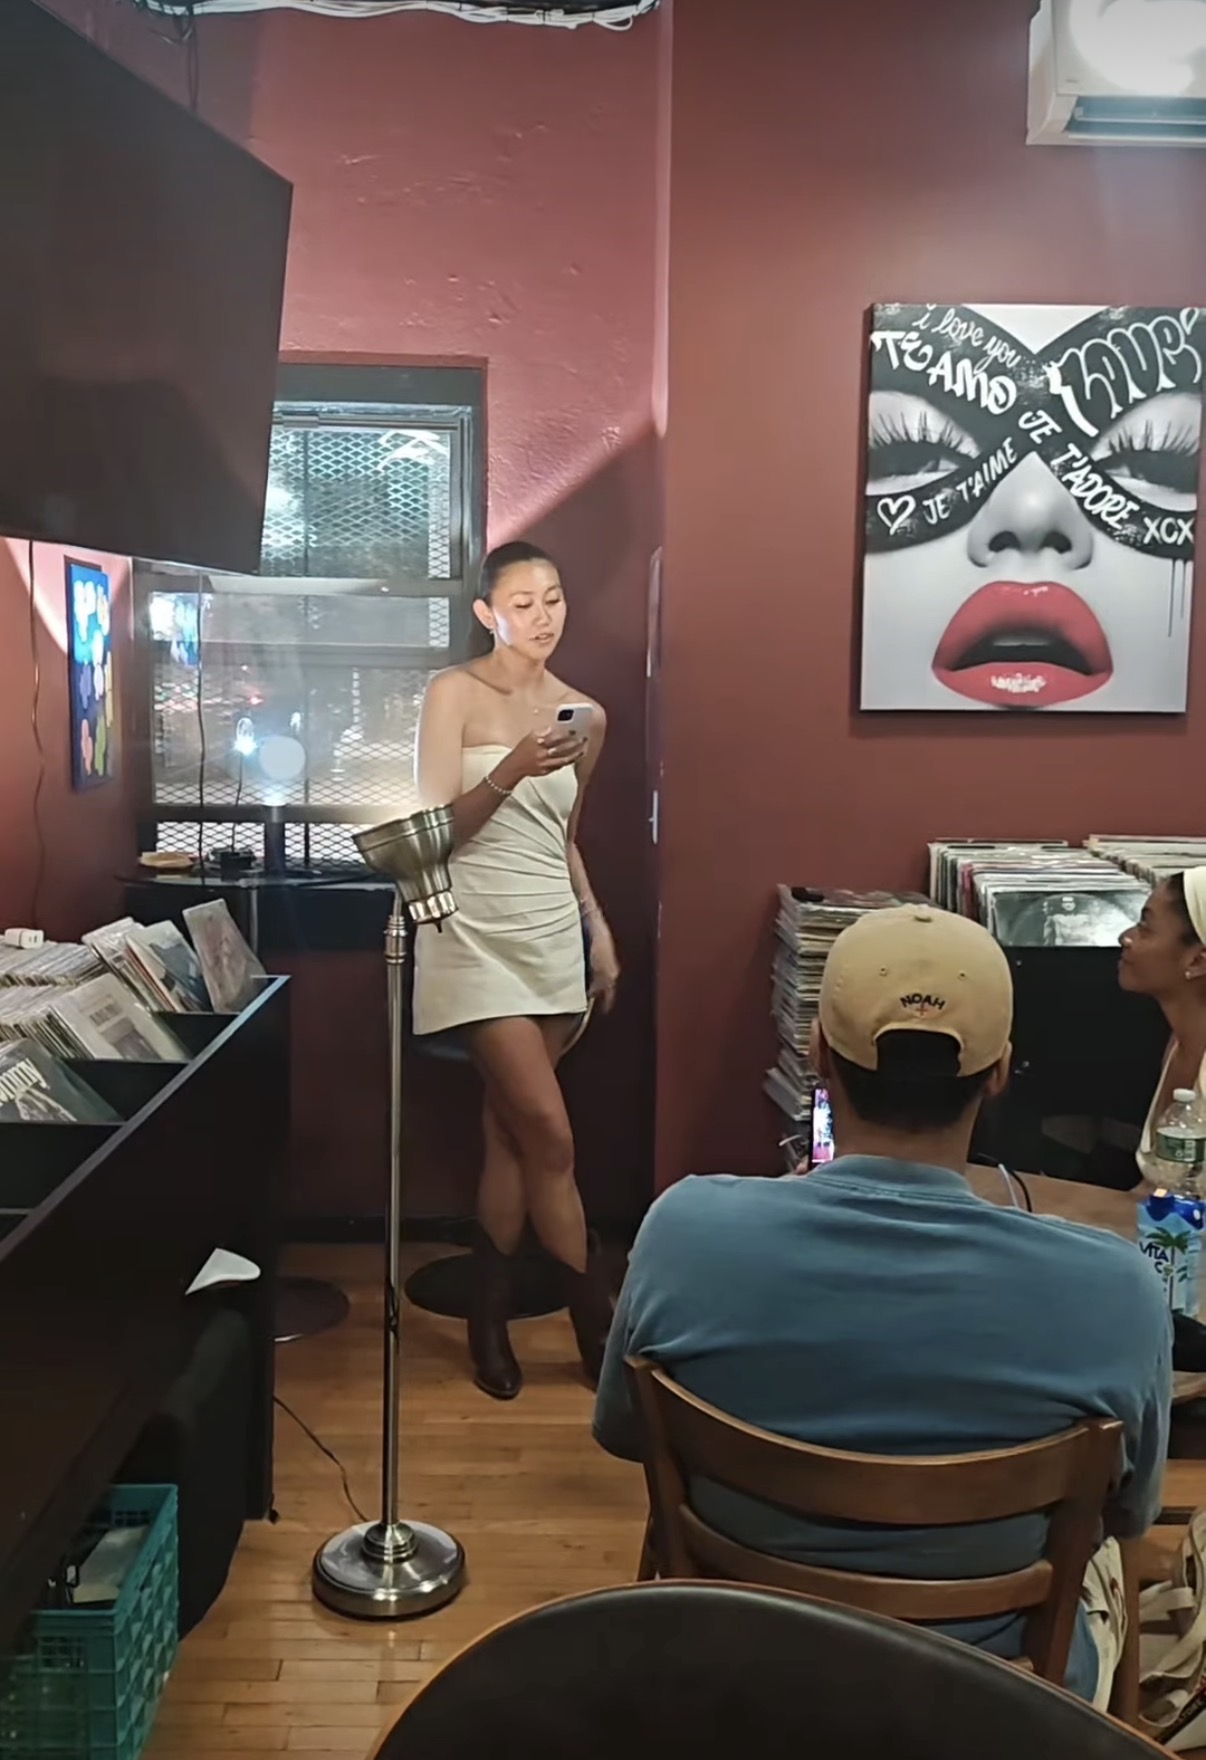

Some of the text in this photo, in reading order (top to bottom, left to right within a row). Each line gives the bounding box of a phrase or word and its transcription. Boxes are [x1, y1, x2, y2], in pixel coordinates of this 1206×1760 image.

[931, 308, 984, 347] love
[982, 336, 1021, 375] you
[926, 351, 1017, 415] AMO
[922, 437, 1017, 525] JE T'AIME
[1018, 410, 1140, 529] JE T'ADORE
[900, 993, 946, 1010] NOAH
[1139, 1241, 1169, 1262] VITA
